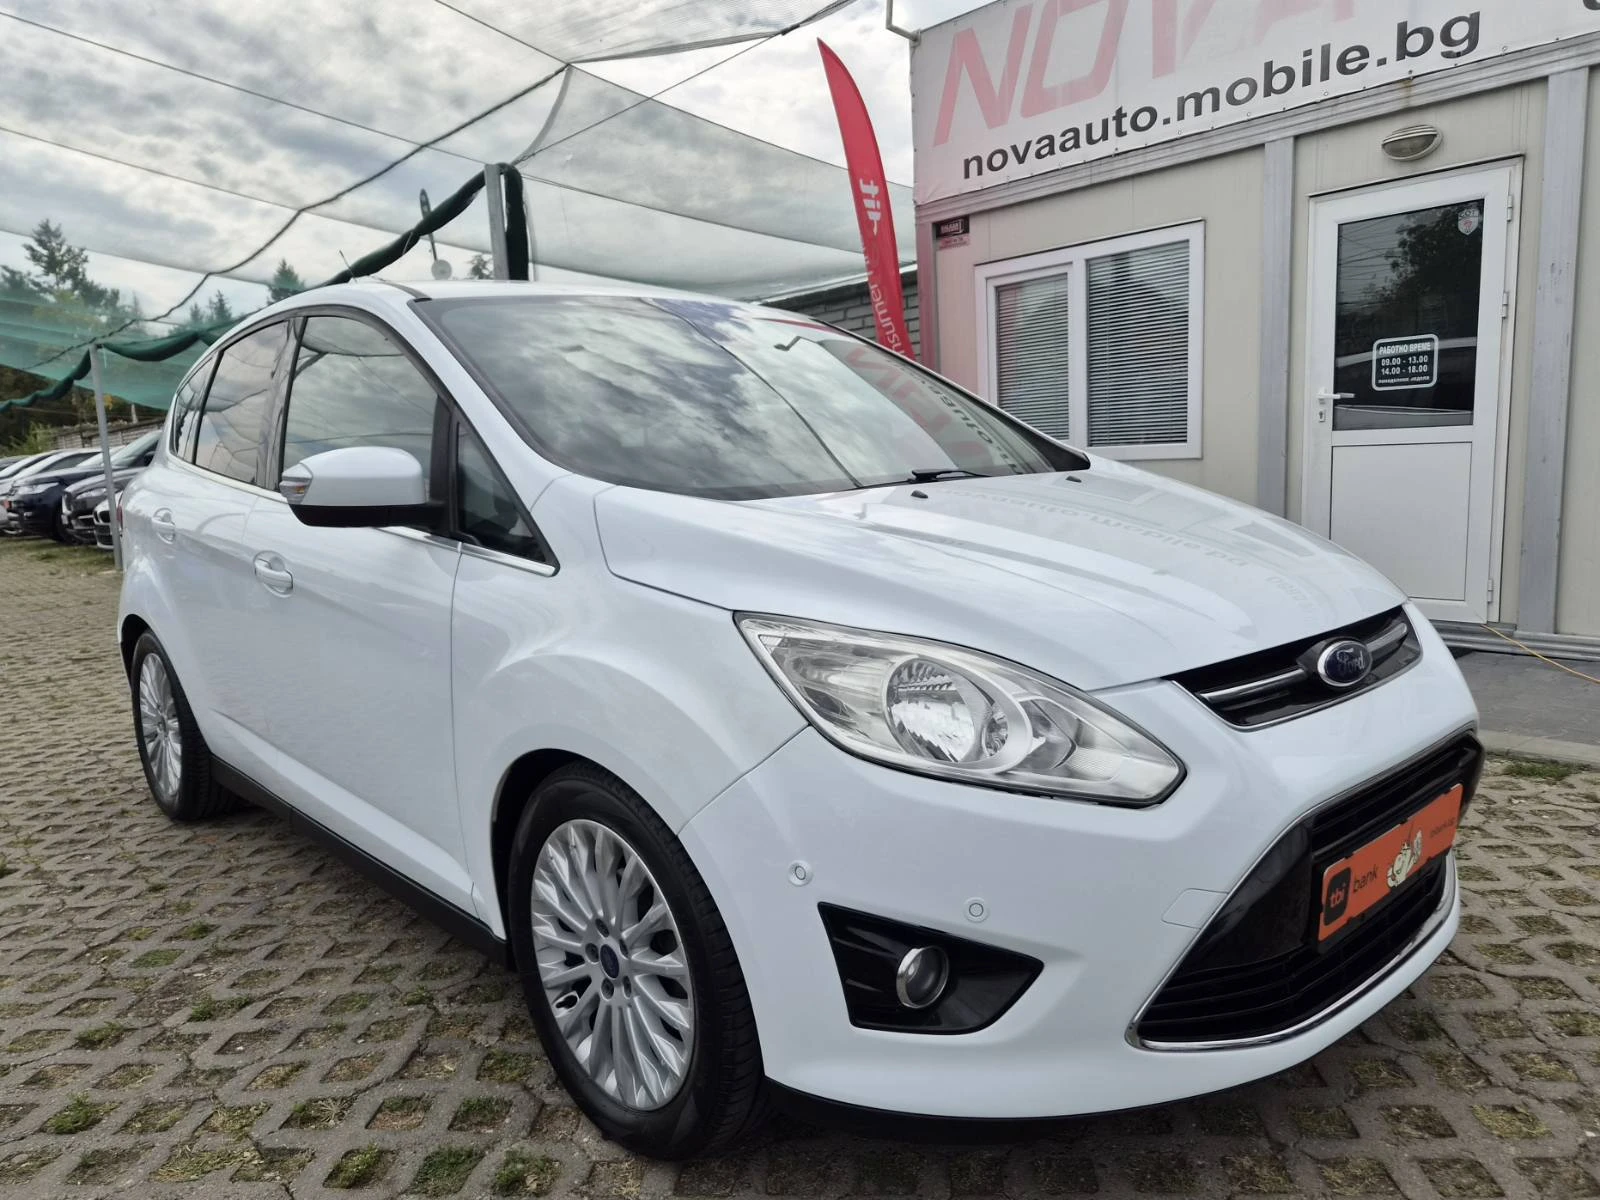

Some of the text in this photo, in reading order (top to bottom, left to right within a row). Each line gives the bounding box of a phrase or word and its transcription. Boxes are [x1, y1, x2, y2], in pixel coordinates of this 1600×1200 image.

[963, 11, 1480, 179] novaauto.mobile.bg
[1379, 342, 1431, 355] РАБОТНО ВРЕМЕ
[1381, 357, 1401, 366] 09.00
[1408, 355, 1428, 364] 13.00
[1381, 367, 1401, 375] 14.00
[1407, 365, 1428, 373] 18.00
[1353, 863, 1380, 893] bank
